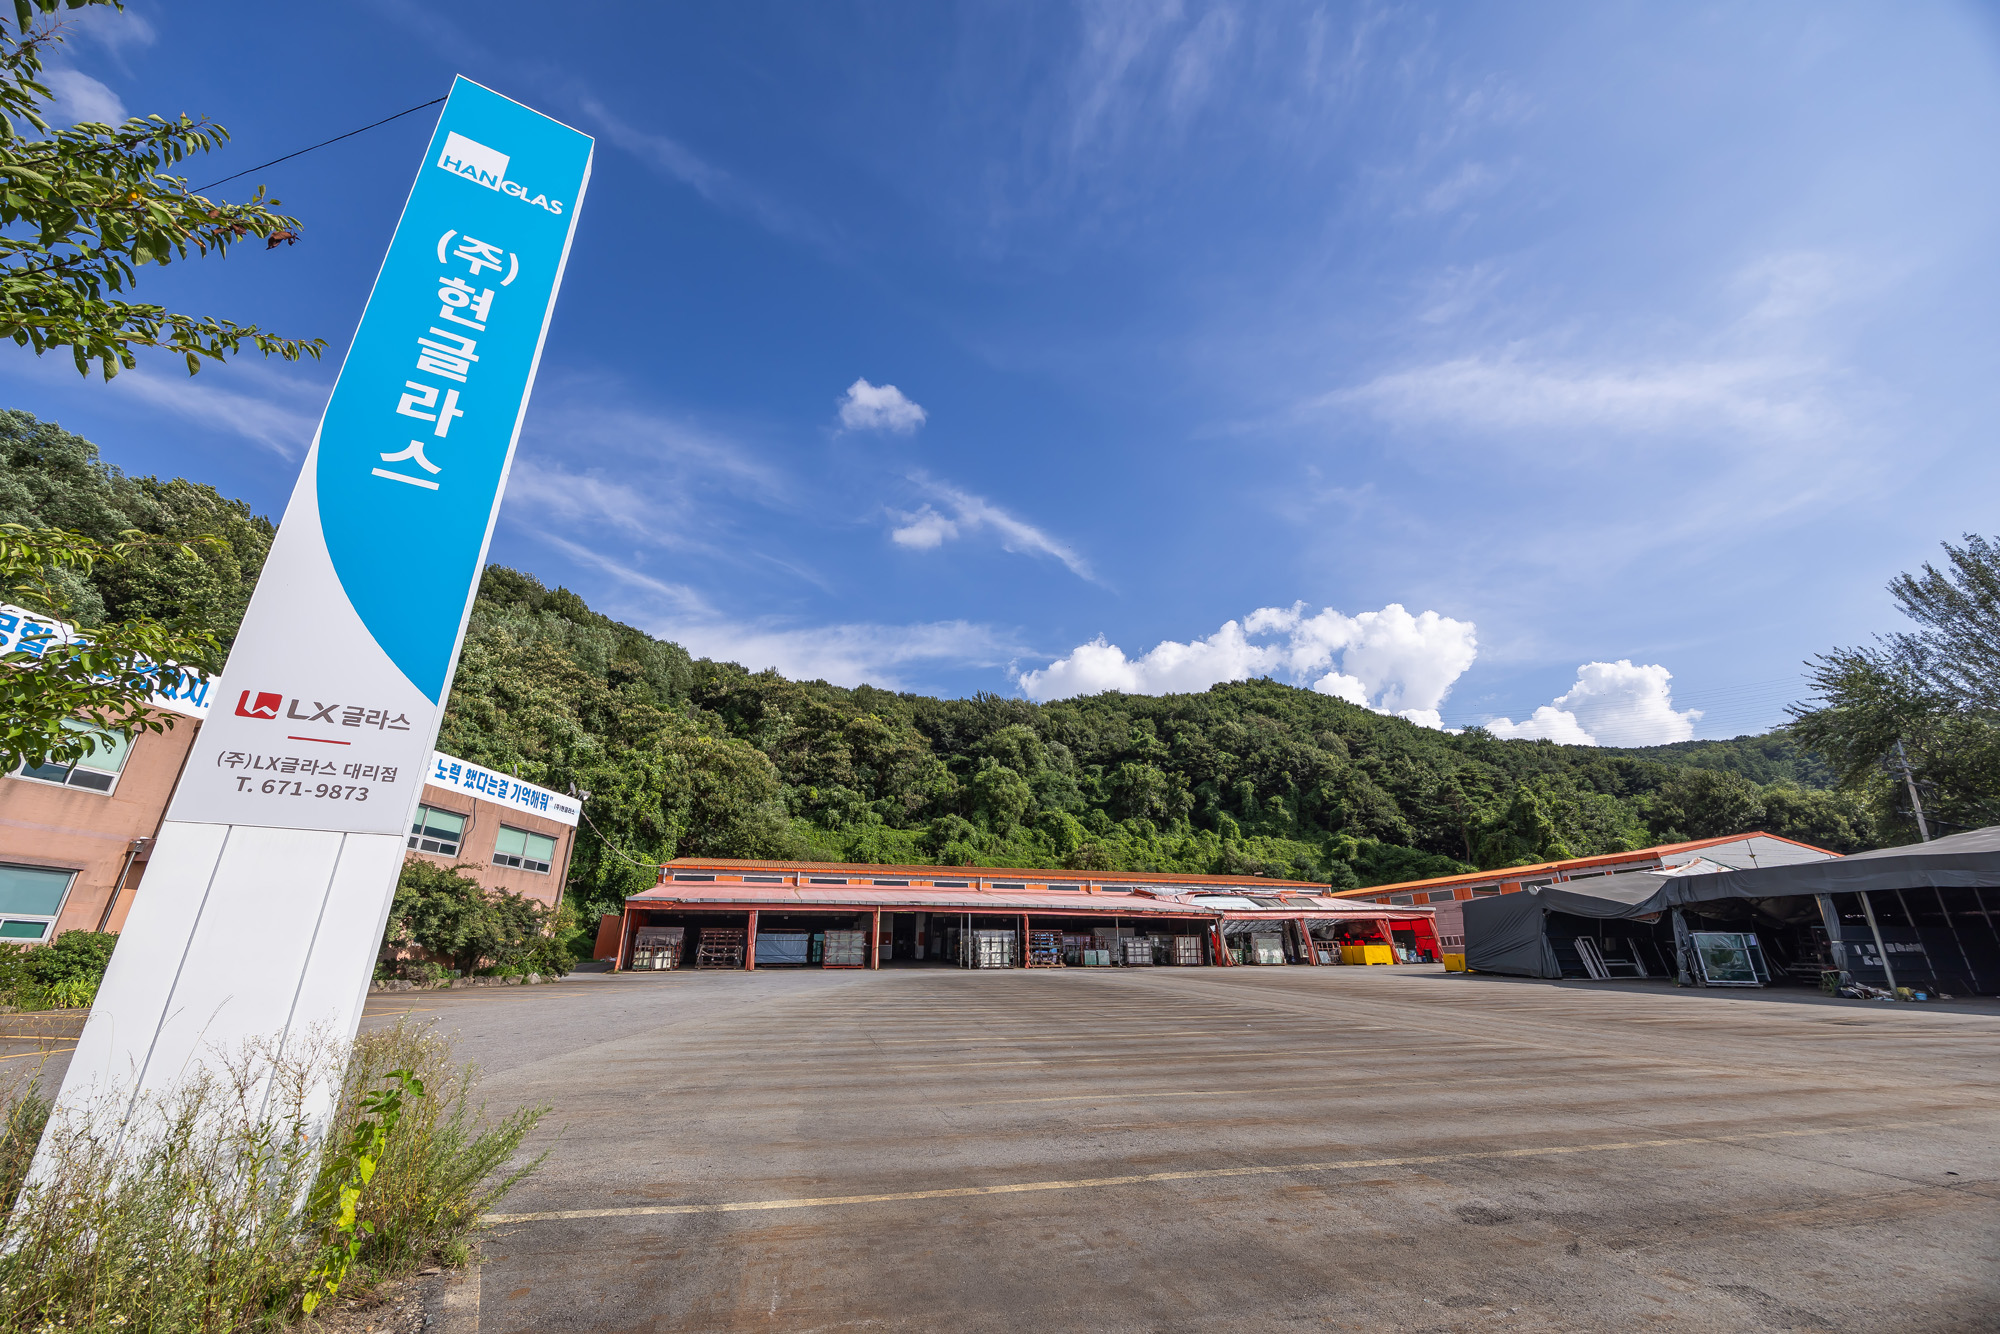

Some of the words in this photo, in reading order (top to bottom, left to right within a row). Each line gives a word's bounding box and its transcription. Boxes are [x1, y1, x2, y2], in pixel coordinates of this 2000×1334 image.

[443, 155, 563, 215] HANGLAS
[217, 750, 337, 776] (주)LX글라스
[343, 763, 398, 783] 대리점
[434, 759, 462, 784] 노력
[463, 768, 509, 799] 했다는걸
[236, 776, 253, 793] T.
[261, 779, 369, 802] 671-9873
